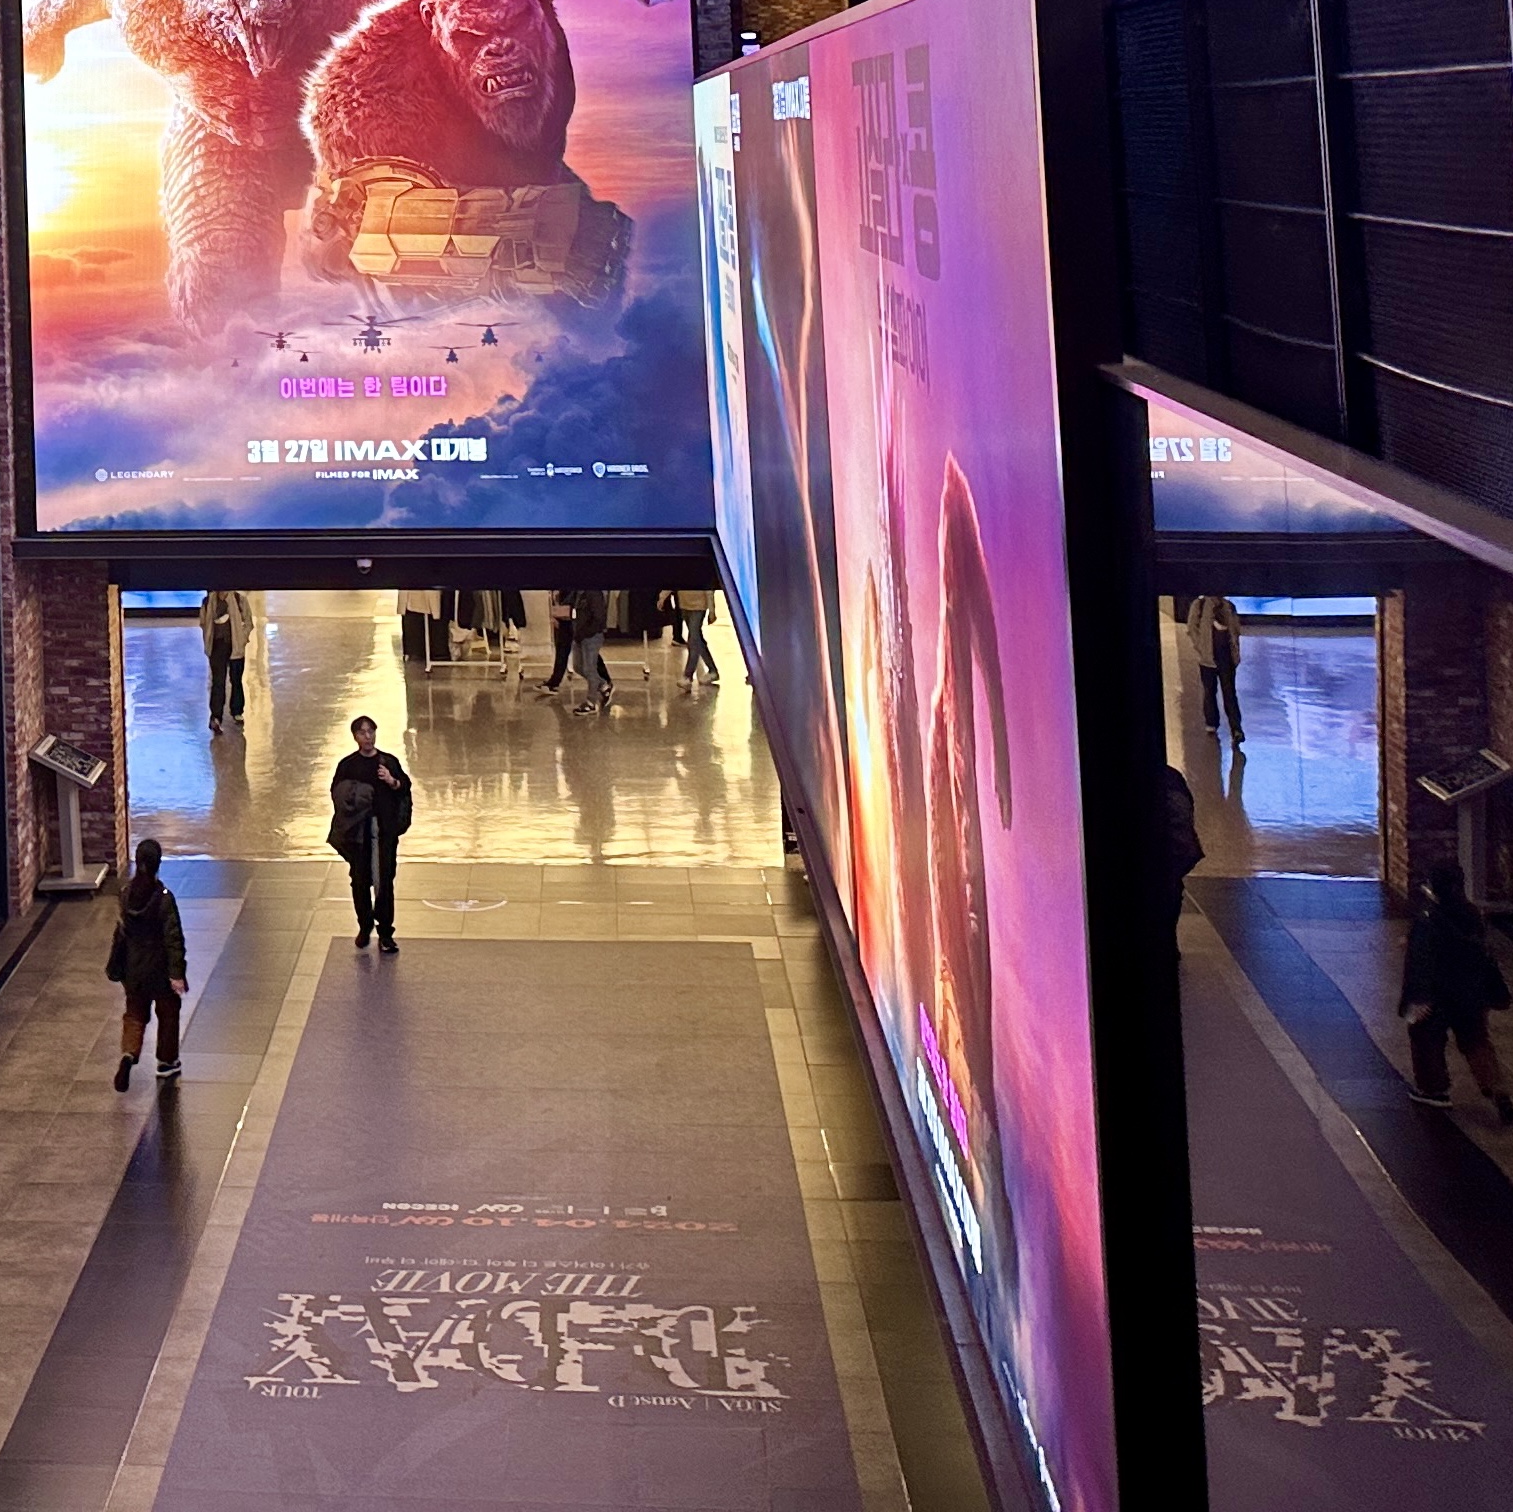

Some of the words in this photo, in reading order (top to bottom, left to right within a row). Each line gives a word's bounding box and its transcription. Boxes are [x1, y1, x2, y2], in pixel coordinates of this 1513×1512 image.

[280, 376, 354, 399] 이번에는
[363, 376, 381, 397] 한
[391, 375, 447, 397] 팀이다
[247, 440, 279, 463] 3월
[285, 439, 328, 463] 27일
[334, 439, 429, 461] IMAX
[431, 437, 488, 462] 대개봉
[110, 470, 175, 479] LEGENDARY
[315, 470, 349, 479] FILMED
[352, 470, 370, 479] FOR
[372, 469, 419, 480] IMAX
[390, 1214, 455, 1227] CGV
[370, 1268, 533, 1296] MOVIE
[538, 1272, 645, 1299] THE
[261, 1383, 326, 1401] TOUR
[607, 1394, 627, 1409] D
[638, 1394, 697, 1411] Agust
[720, 1397, 783, 1414] SUGA
